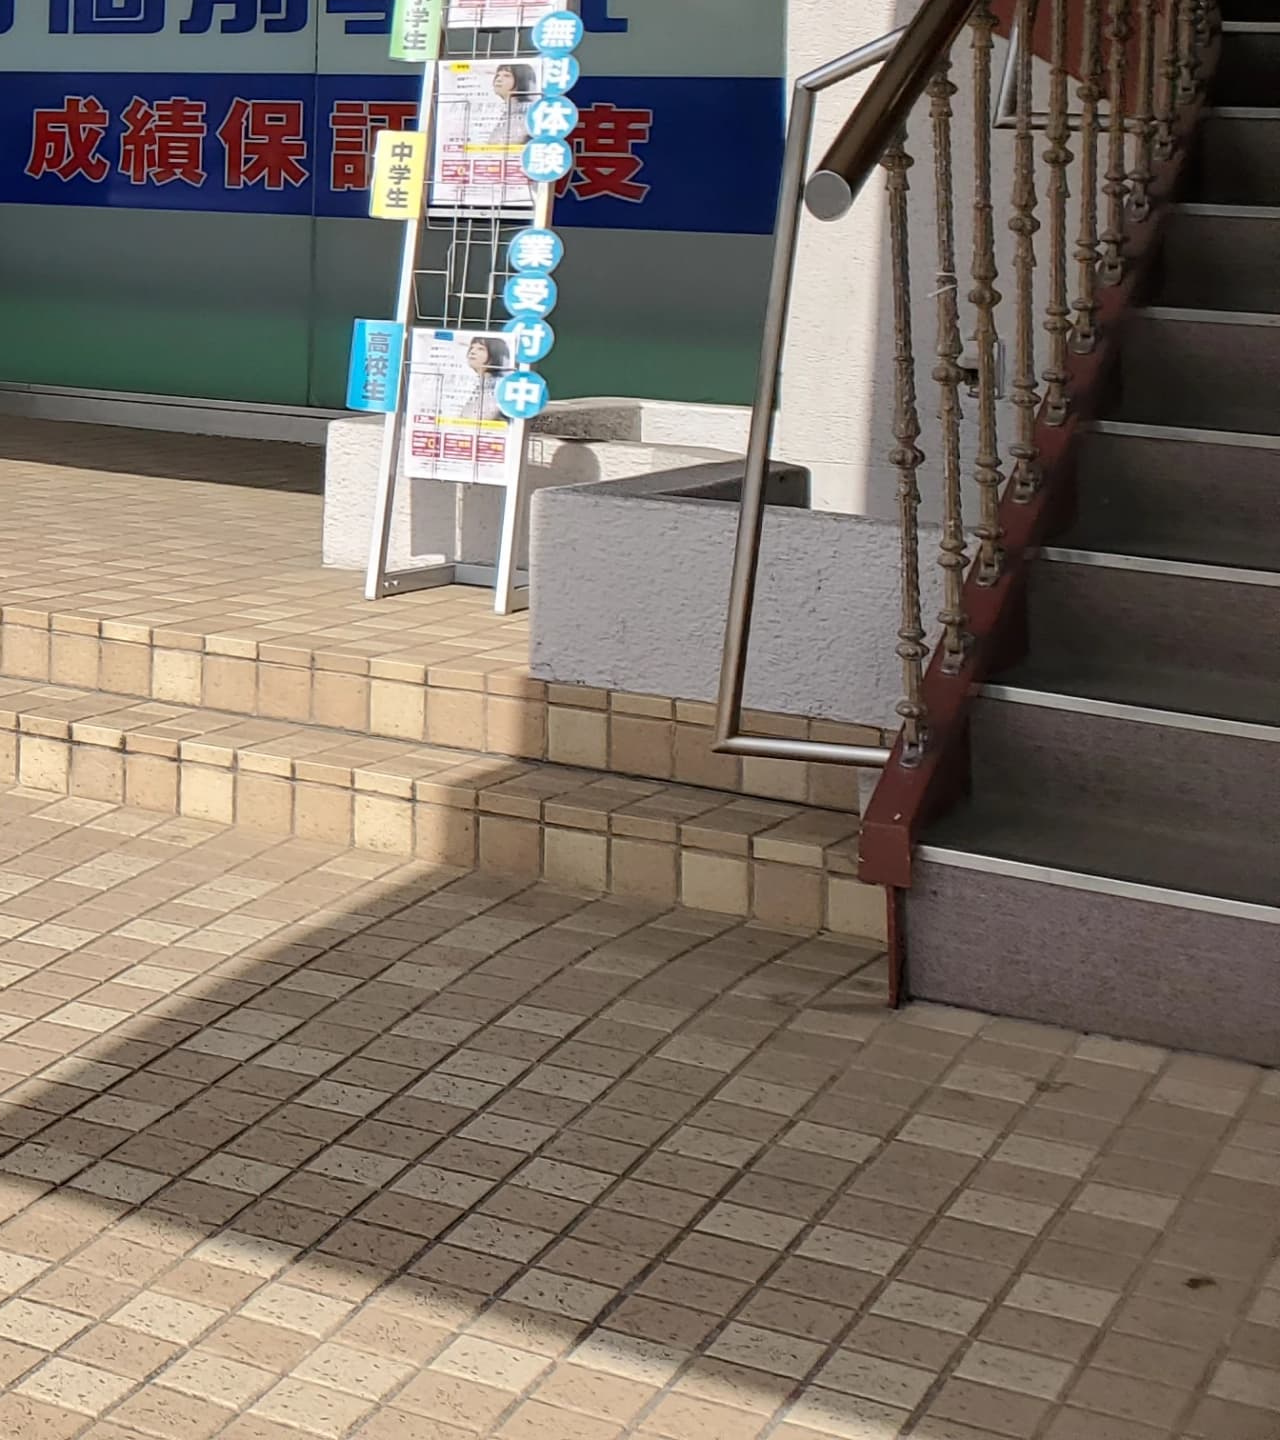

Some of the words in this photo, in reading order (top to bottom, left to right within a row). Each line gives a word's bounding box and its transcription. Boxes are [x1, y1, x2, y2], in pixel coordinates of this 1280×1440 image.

[24, 95, 653, 203] 成績保証度
[385, 141, 413, 209] 中学生
[361, 332, 392, 402] 高校生
